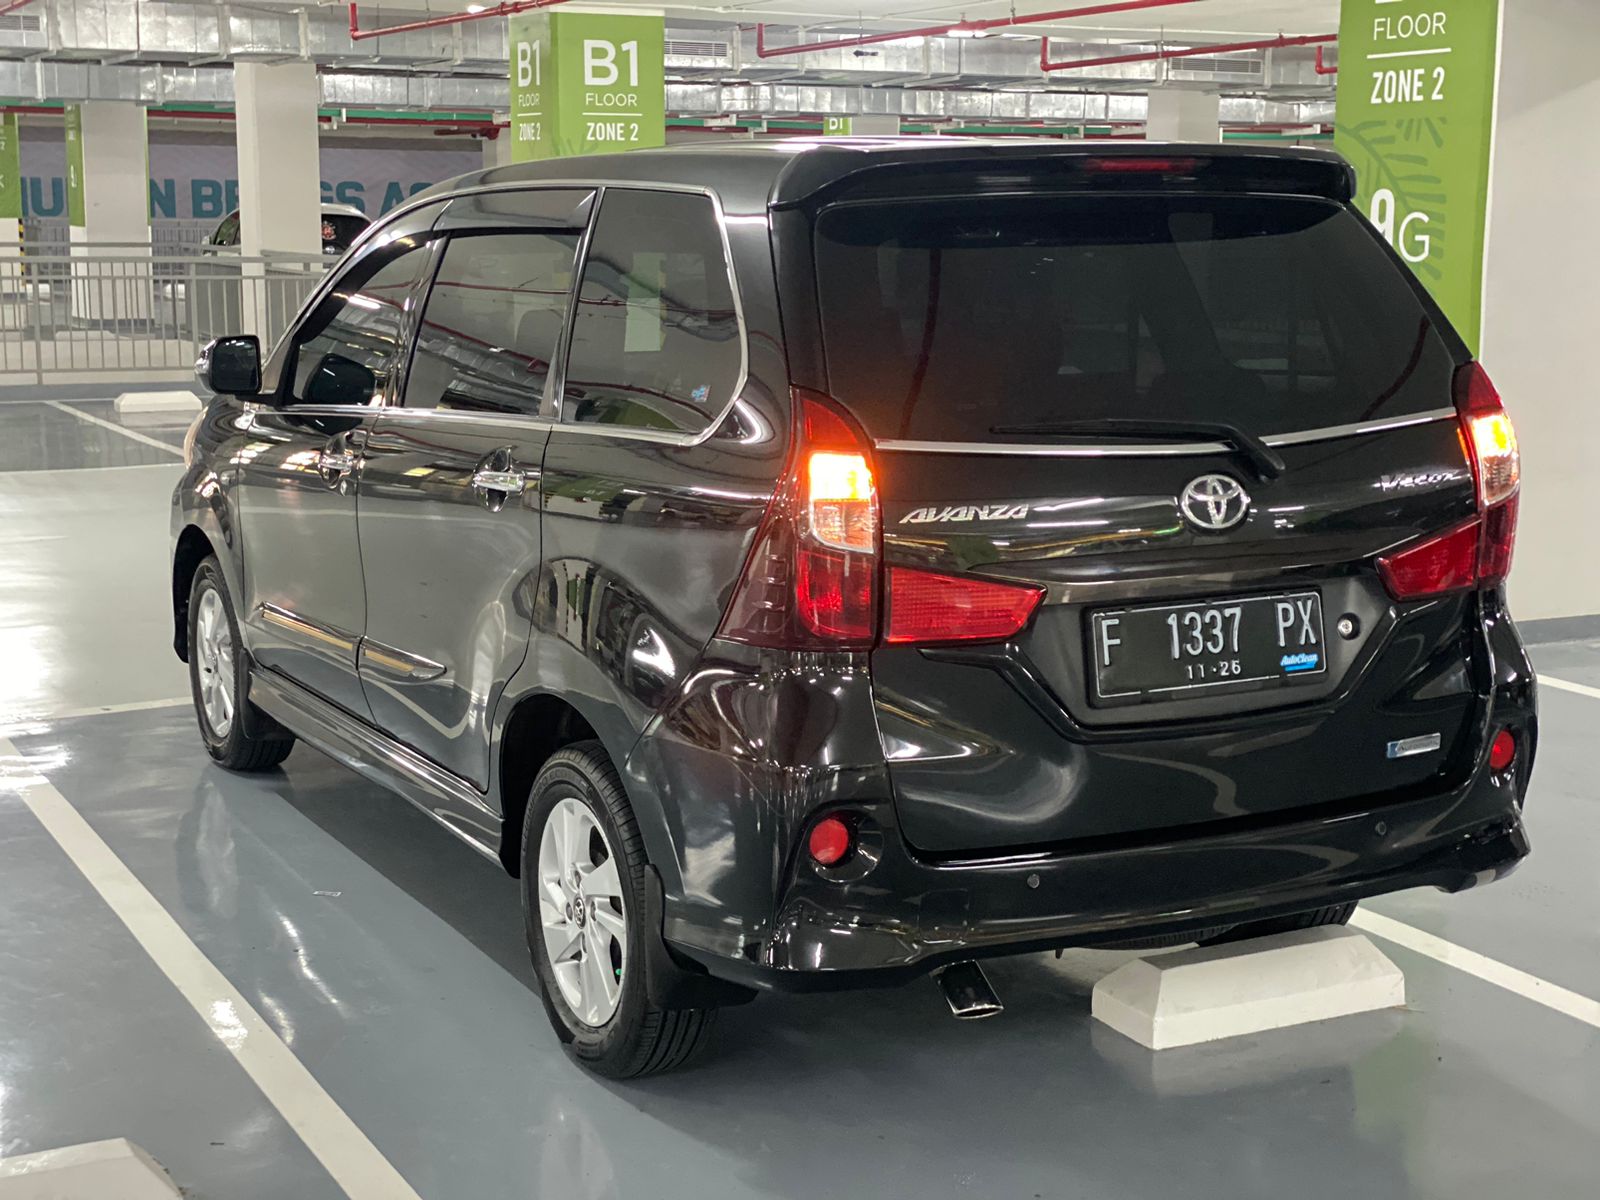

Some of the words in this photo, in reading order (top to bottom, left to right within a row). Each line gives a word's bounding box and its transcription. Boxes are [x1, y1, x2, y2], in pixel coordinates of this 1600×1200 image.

[1373, 12, 1446, 40] FLOOR
[517, 40, 540, 87] B1
[583, 39, 638, 87] B1
[1370, 69, 1424, 104] ZONE
[1431, 66, 1445, 100] 2
[518, 93, 540, 107] FLOOR
[585, 93, 637, 106] FLOOR
[519, 123, 535, 141] ZONE
[536, 122, 541, 140] 2
[586, 122, 625, 141] ZONE
[629, 123, 639, 141] 2
[900, 504, 1030, 524] AVANZA
[1101, 618, 1121, 666] F
[1167, 606, 1242, 660] 1337
[1277, 599, 1317, 648] PX
[1280, 652, 1319, 667] AutoClean
